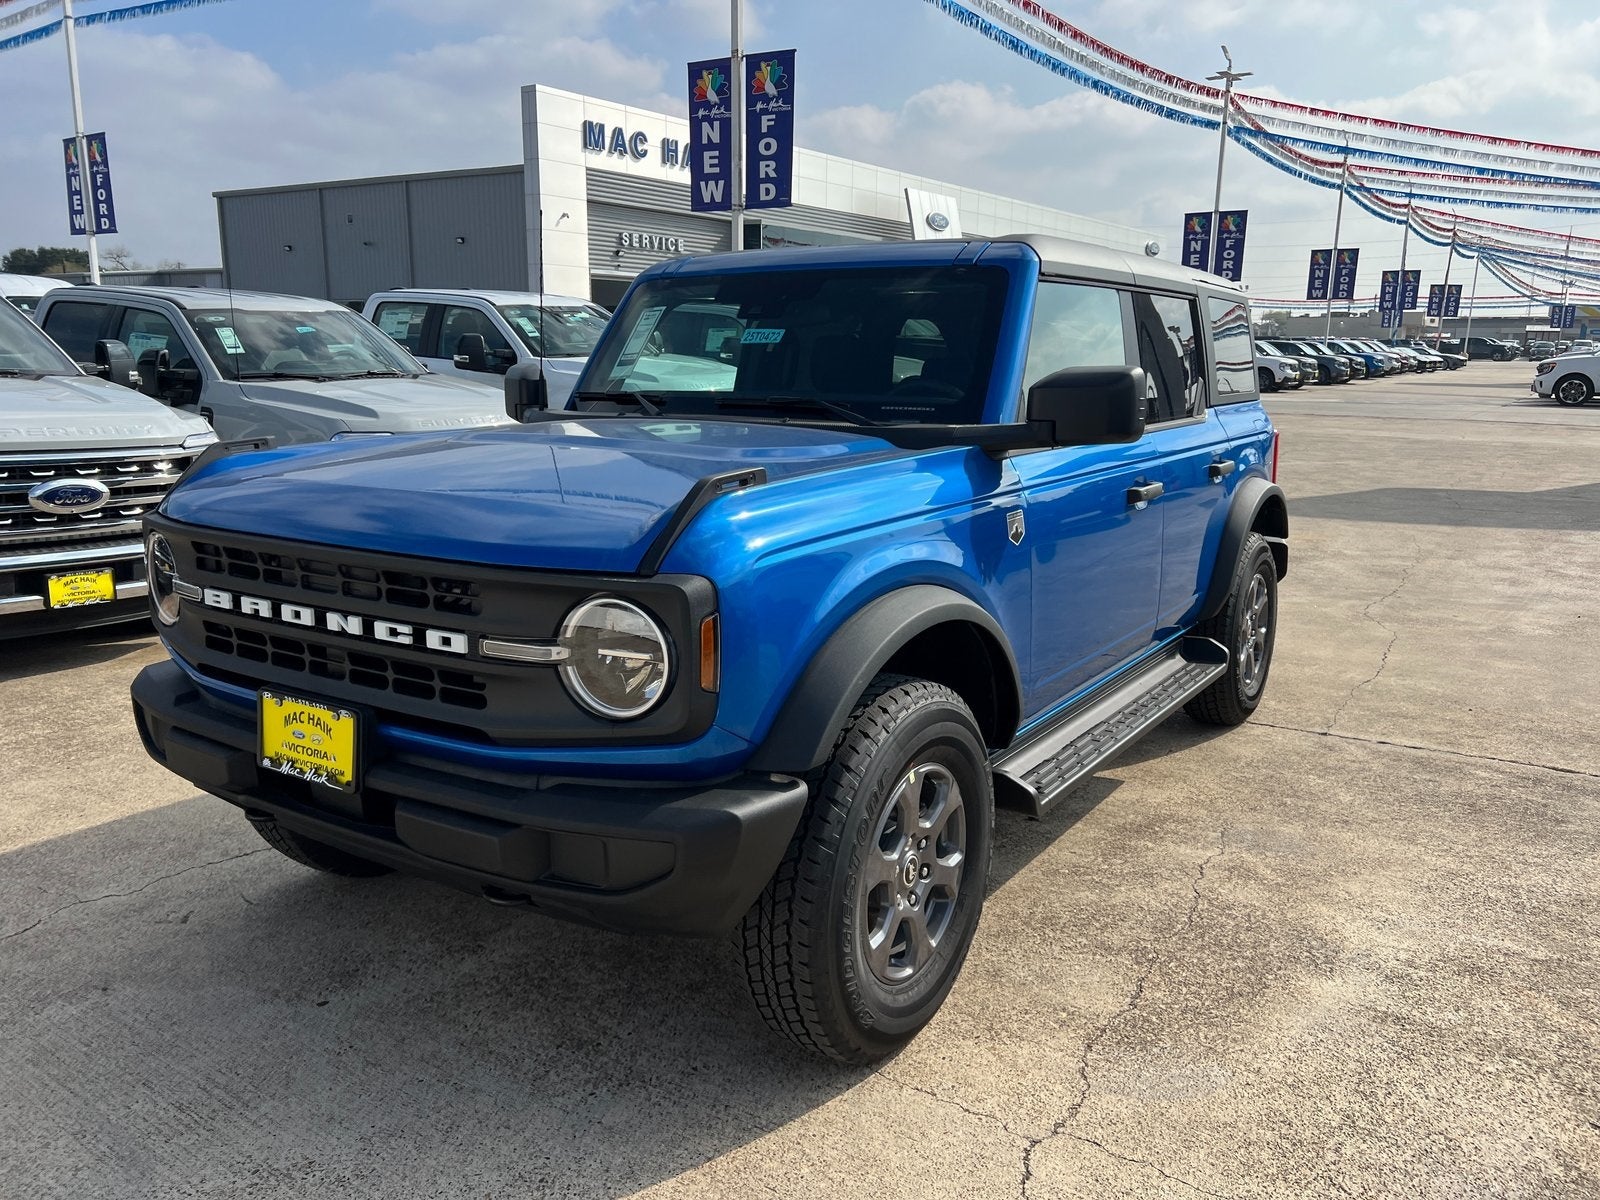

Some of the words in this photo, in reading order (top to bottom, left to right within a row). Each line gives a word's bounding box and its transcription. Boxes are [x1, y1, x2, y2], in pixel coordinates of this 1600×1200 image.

[583, 119, 648, 160] MAC
[700, 121, 725, 203] NEW
[758, 114, 778, 201] FORD
[71, 176, 85, 229] NEW
[96, 174, 109, 229] FORD
[621, 232, 685, 251] SERVICE
[1189, 240, 1202, 266] NE
[1222, 239, 1235, 279] FORD
[1311, 269, 1324, 298] NEW
[1338, 268, 1350, 298] FORD
[1404, 285, 1413, 308] FORD
[1383, 286, 1392, 309] NEW
[1430, 297, 1439, 316] NEW
[1447, 297, 1456, 316] FORD
[743, 331, 781, 342] 25T0472
[54, 488, 91, 505] Ford
[203, 588, 469, 654] BRONCO
[283, 711, 305, 729] MAC
[307, 712, 333, 740] HAIK
[287, 741, 329, 761] VICTORIA
[280, 760, 303, 778] Mac
[303, 768, 329, 784] Haik
